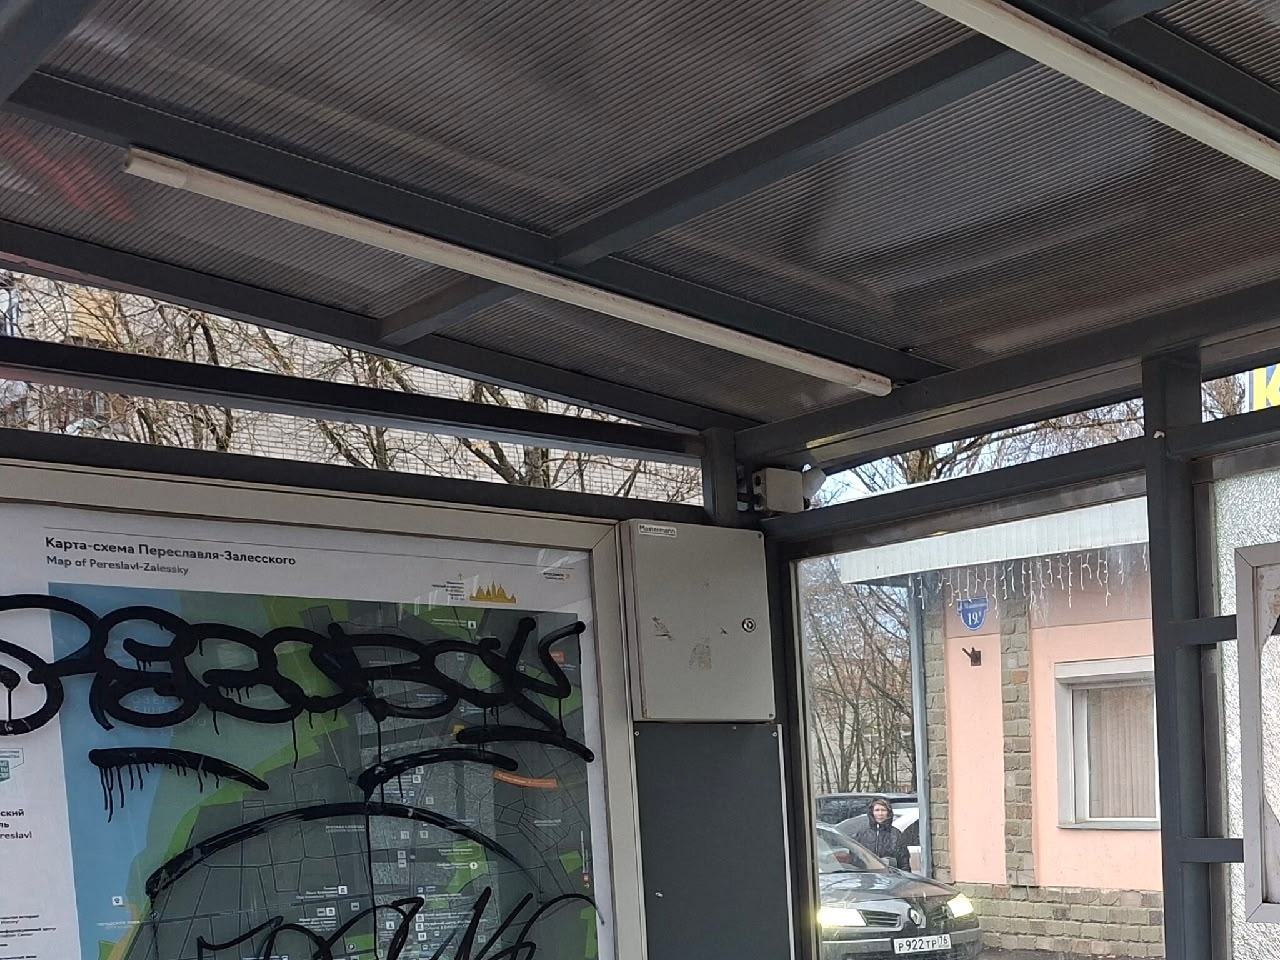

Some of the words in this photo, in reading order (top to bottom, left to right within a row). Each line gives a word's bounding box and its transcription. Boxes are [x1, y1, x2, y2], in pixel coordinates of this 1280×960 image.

[45, 536, 135, 554] Карта-схема
[138, 543, 296, 565] Переславля-Залесского
[46, 555, 72, 568] Map
[75, 558, 88, 567] of
[89, 558, 189, 576] Pereslavl-Zalessky
